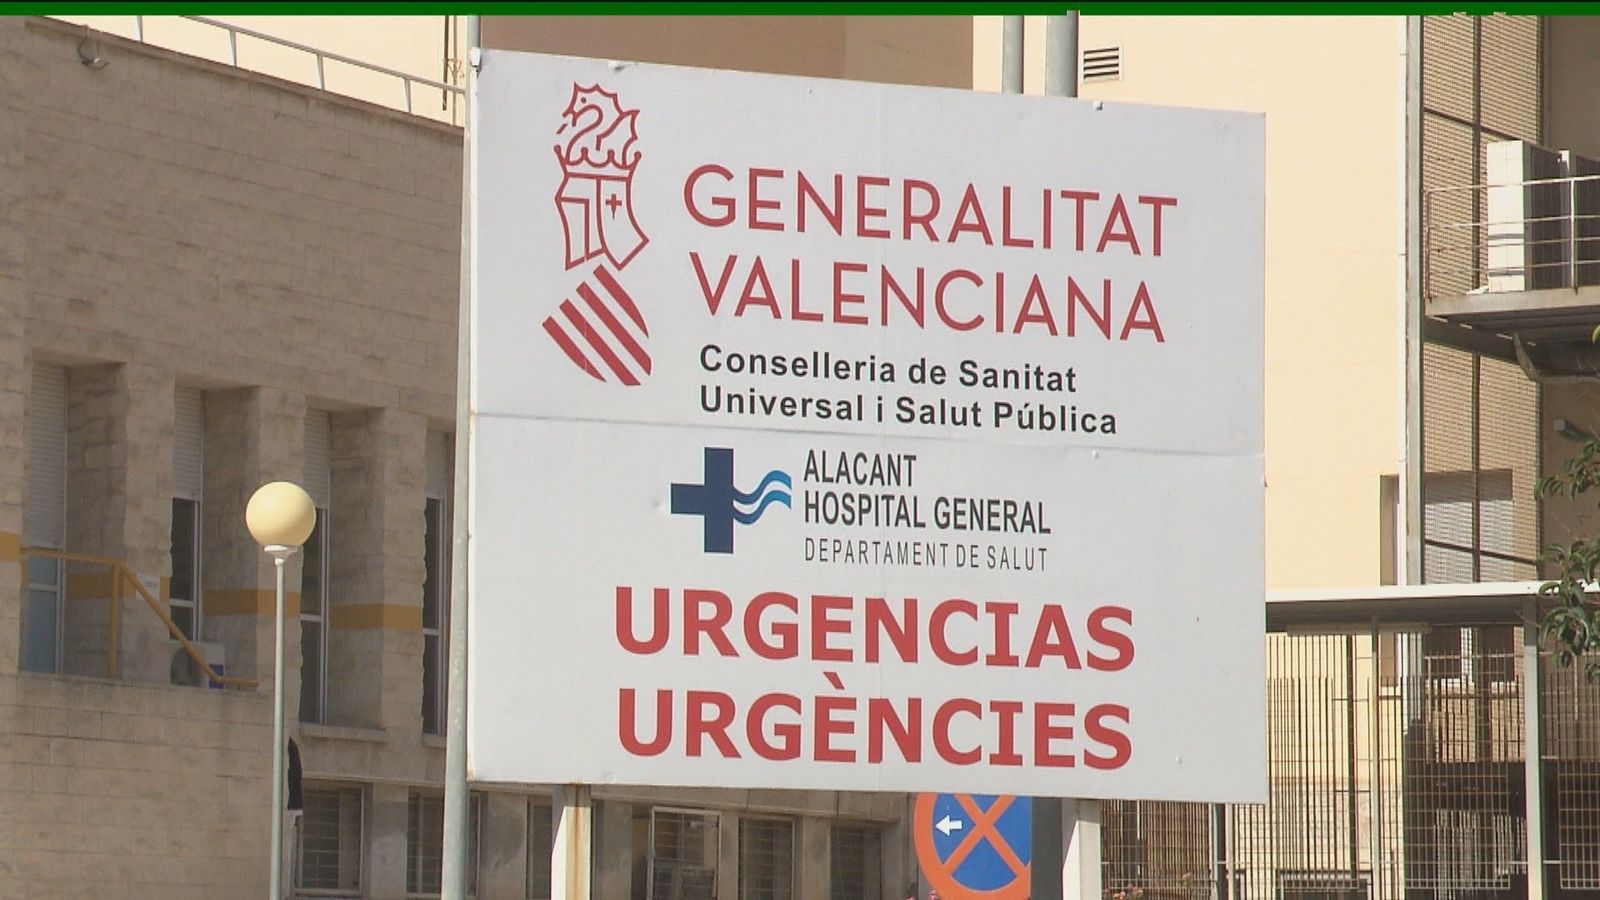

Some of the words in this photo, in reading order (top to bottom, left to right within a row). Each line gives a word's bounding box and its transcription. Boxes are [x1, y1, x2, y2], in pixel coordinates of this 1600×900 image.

[684, 163, 1178, 257] GENERALITAT
[689, 251, 1166, 343] VALENCIANA
[700, 343, 896, 384] Conselleria
[908, 357, 947, 388] de
[958, 359, 1077, 393] Sanitat
[700, 384, 863, 422] Universal
[876, 396, 883, 423] i
[895, 397, 982, 429] Salut
[994, 401, 1117, 435] Pública
[803, 449, 917, 488] ALACANT
[804, 489, 927, 530] HOSPITAL
[933, 496, 1052, 536] GENERAL
[805, 537, 949, 567] DEPARTAMENT
[956, 544, 980, 569] DE
[986, 546, 1049, 572] SALUT
[615, 586, 1135, 672] URGENCIAS
[618, 671, 1132, 771] URGÈNCIES
